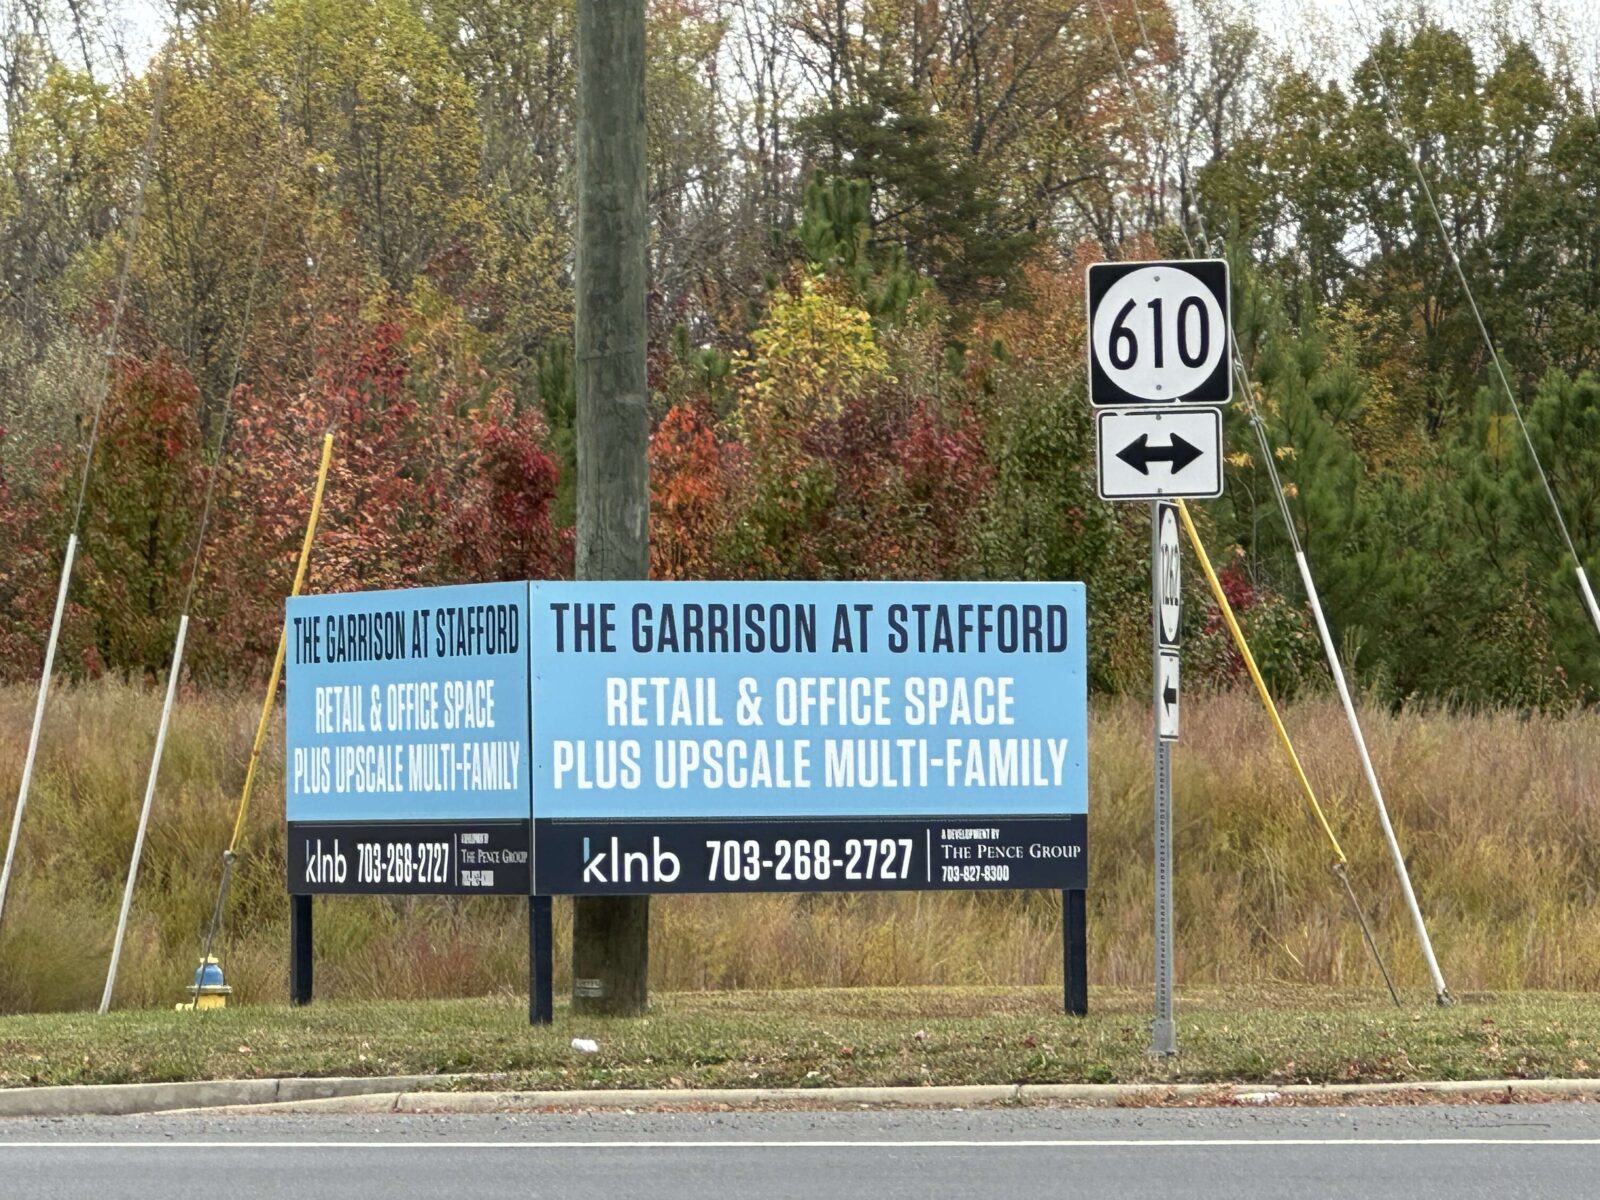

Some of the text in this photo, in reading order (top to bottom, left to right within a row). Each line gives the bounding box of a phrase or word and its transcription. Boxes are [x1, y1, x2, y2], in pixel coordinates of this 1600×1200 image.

[1108, 296, 1210, 370] 610
[294, 604, 518, 664] THE GARRISON AT STAFFORD
[550, 603, 1068, 653] THE GARRISON AT STAFFORD
[316, 680, 495, 733] RETAIL & OFFICE SPACE
[606, 677, 1014, 726] RETAIL & OFFICE SPACE
[294, 741, 520, 793] PLUS UPSCALE MULTI-FAMILY
[553, 738, 1068, 789] PLUS UPSCALE MULTI-FAMILY
[305, 839, 347, 884] klnb
[356, 843, 450, 884] 703-268-2727
[583, 836, 680, 883] klnb
[705, 838, 913, 882] 703-268-2727
[941, 845, 971, 859] THE
[941, 865, 1010, 882] 703-827-8300
